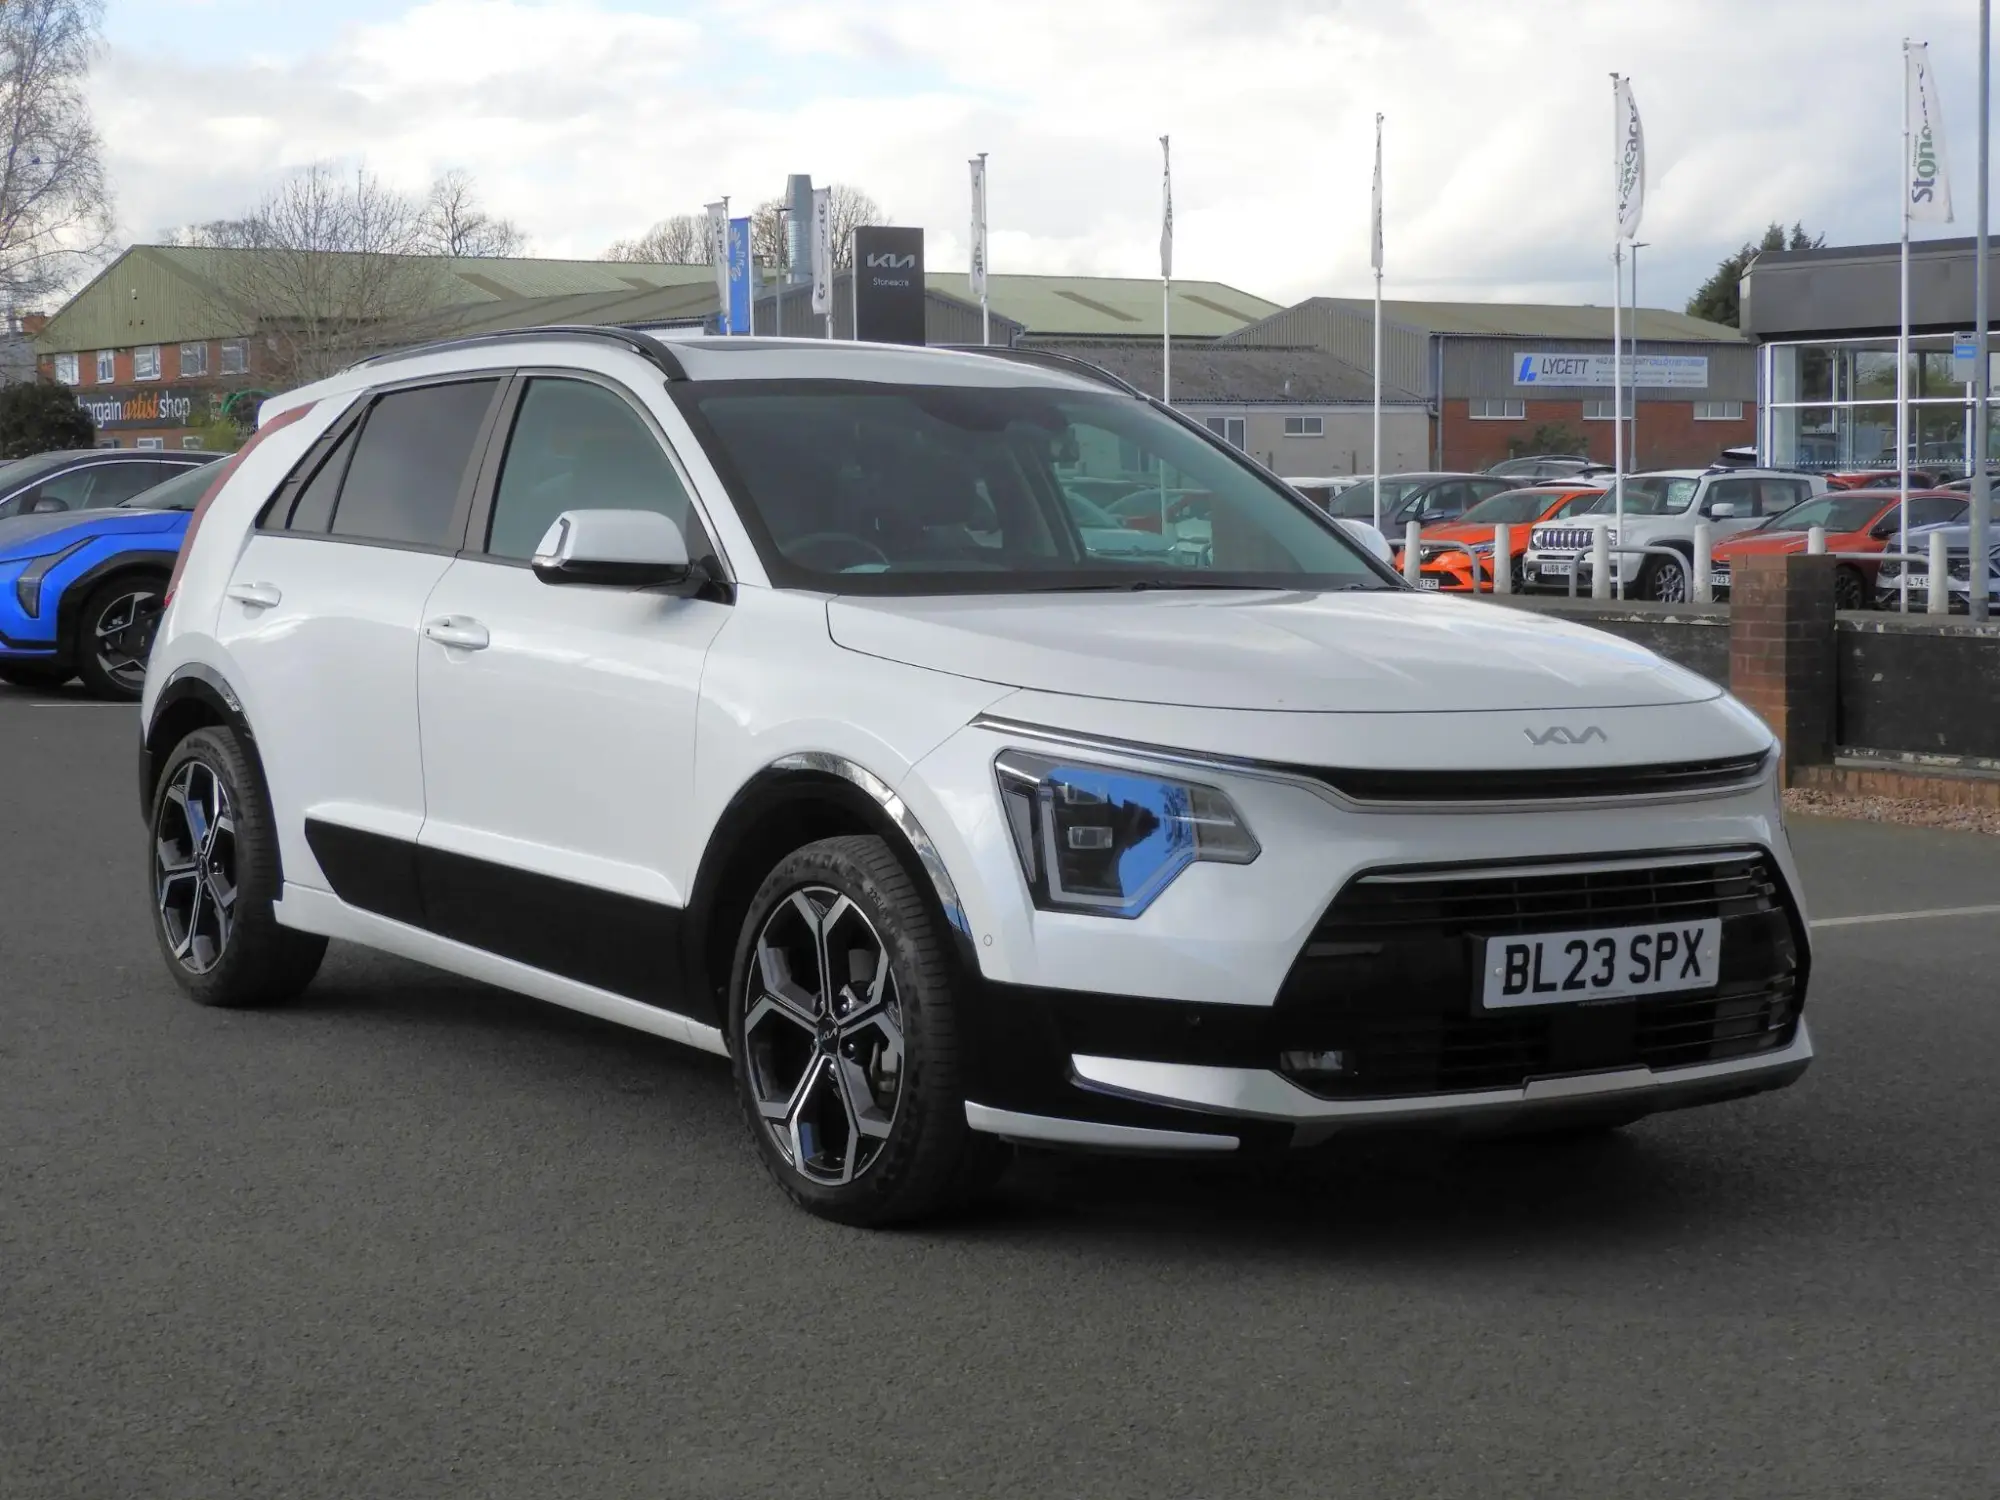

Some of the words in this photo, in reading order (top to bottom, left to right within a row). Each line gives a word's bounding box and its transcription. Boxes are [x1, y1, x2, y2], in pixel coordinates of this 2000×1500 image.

[1541, 358, 1590, 375] LYCETT
[122, 391, 160, 421] artist
[159, 390, 191, 425] shop
[1502, 937, 1617, 996] BL23
[1628, 928, 1704, 984] SPX
